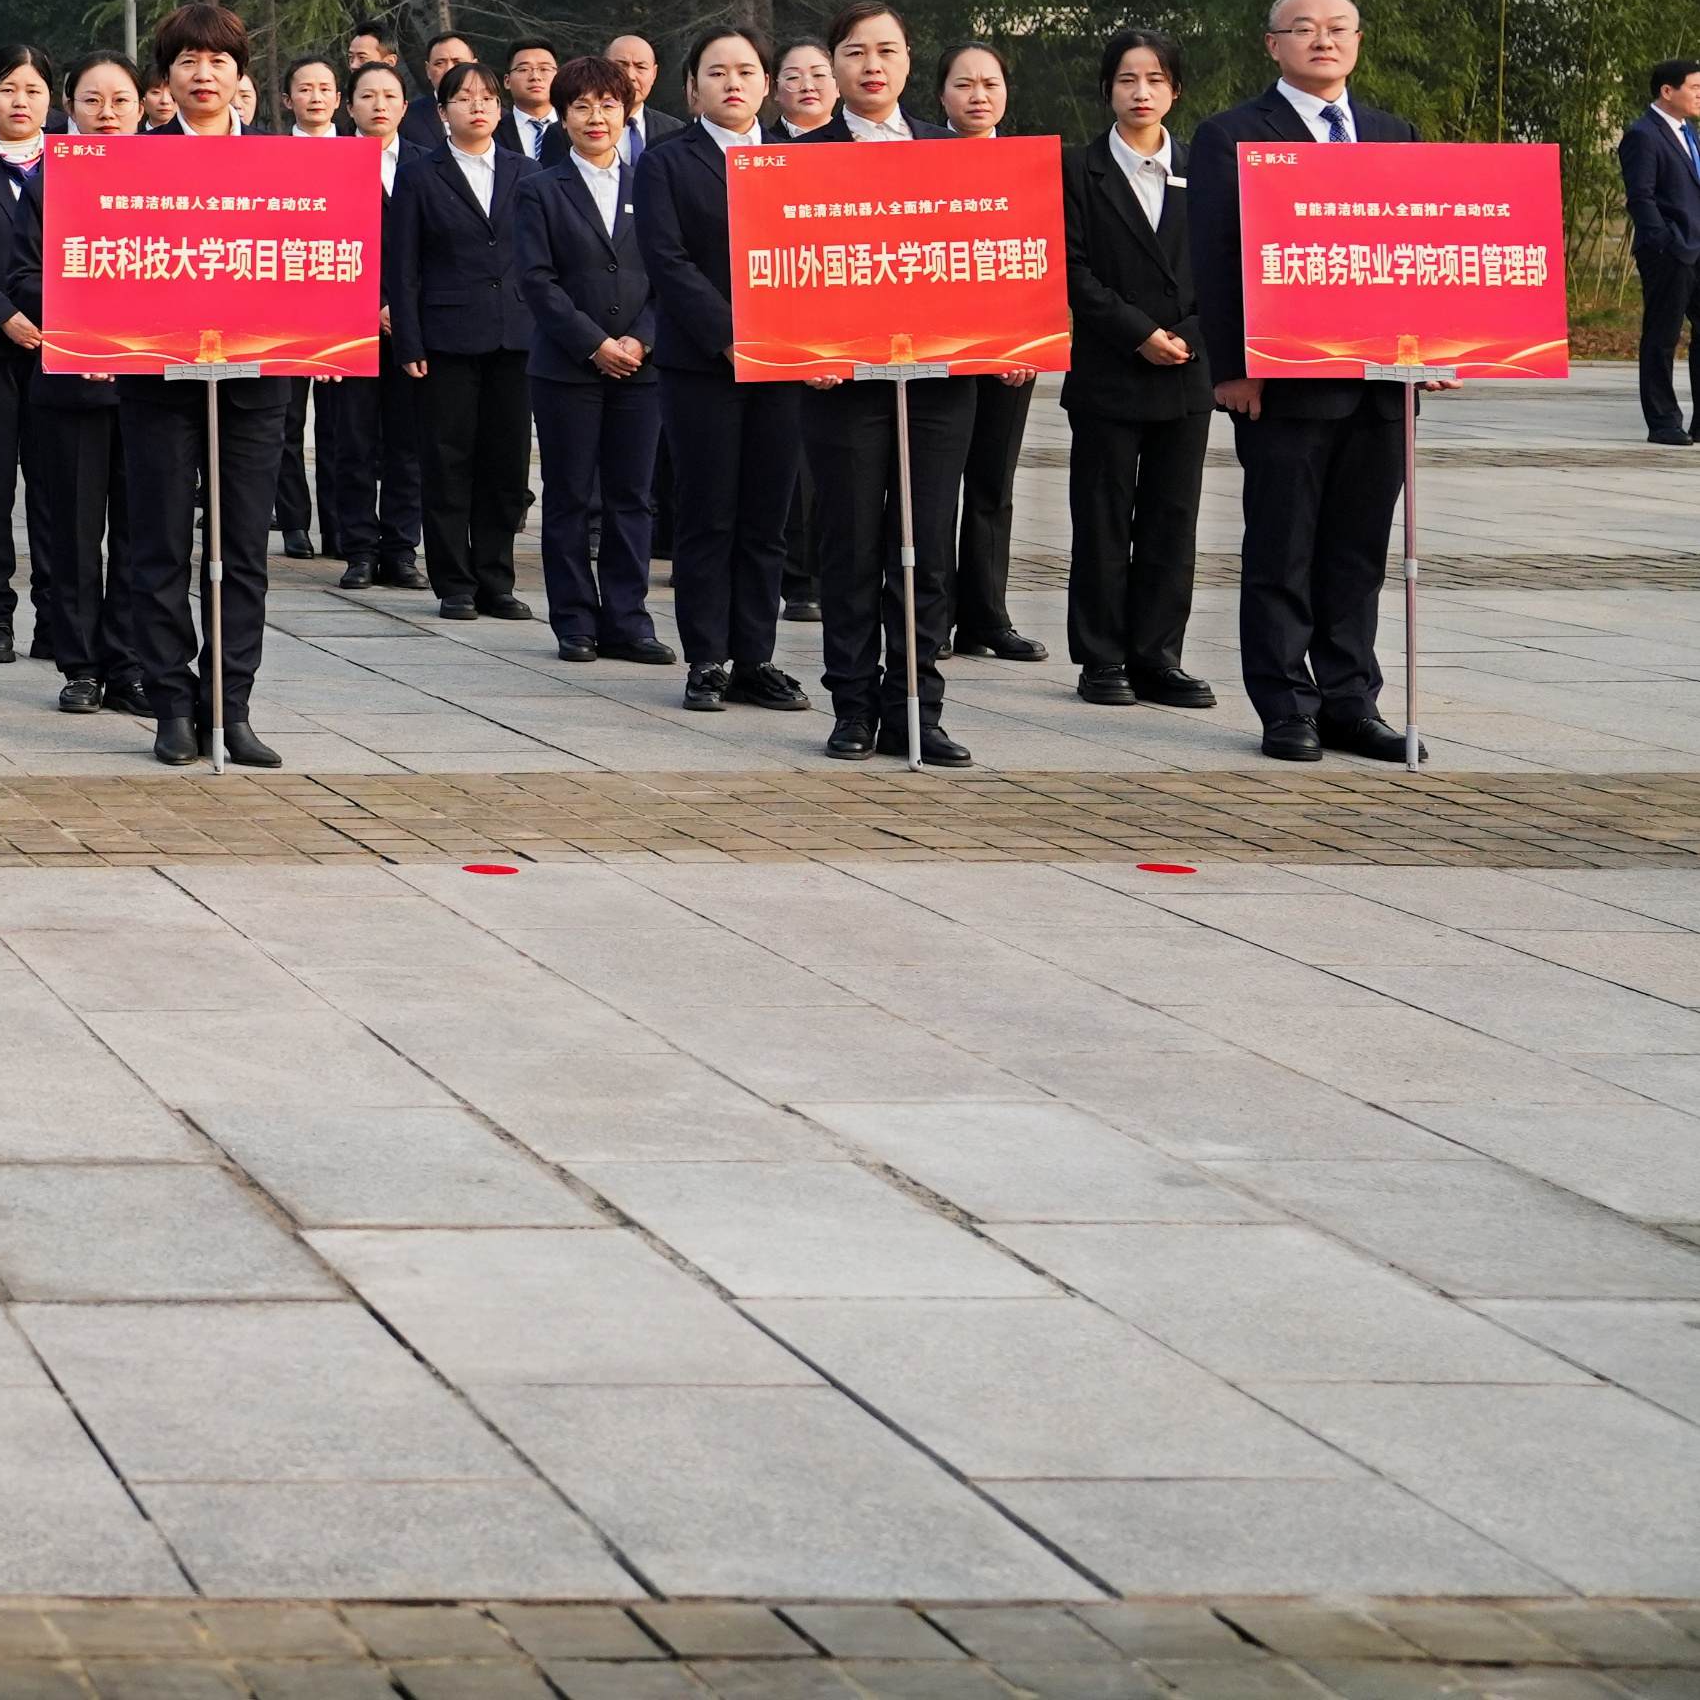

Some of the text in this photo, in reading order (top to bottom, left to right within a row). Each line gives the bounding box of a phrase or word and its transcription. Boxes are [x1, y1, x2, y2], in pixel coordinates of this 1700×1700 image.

[73, 145, 106, 156] 新大正
[1265, 153, 1298, 164] 新大正
[753, 155, 787, 168] 新大正
[100, 195, 326, 211] 智能清洁机器人全面推广启动仪式
[783, 197, 1008, 219] 智能清洁机器人全面推广启动仪式
[1294, 202, 1510, 217] 智能清洁机器人全面推广启动仪式
[62, 236, 363, 282] 重庆科技大学项目管理部
[748, 237, 1048, 289] 四川外国语大学项目管理部
[1261, 243, 1547, 286] 重庆商务职业学院项目管理部
